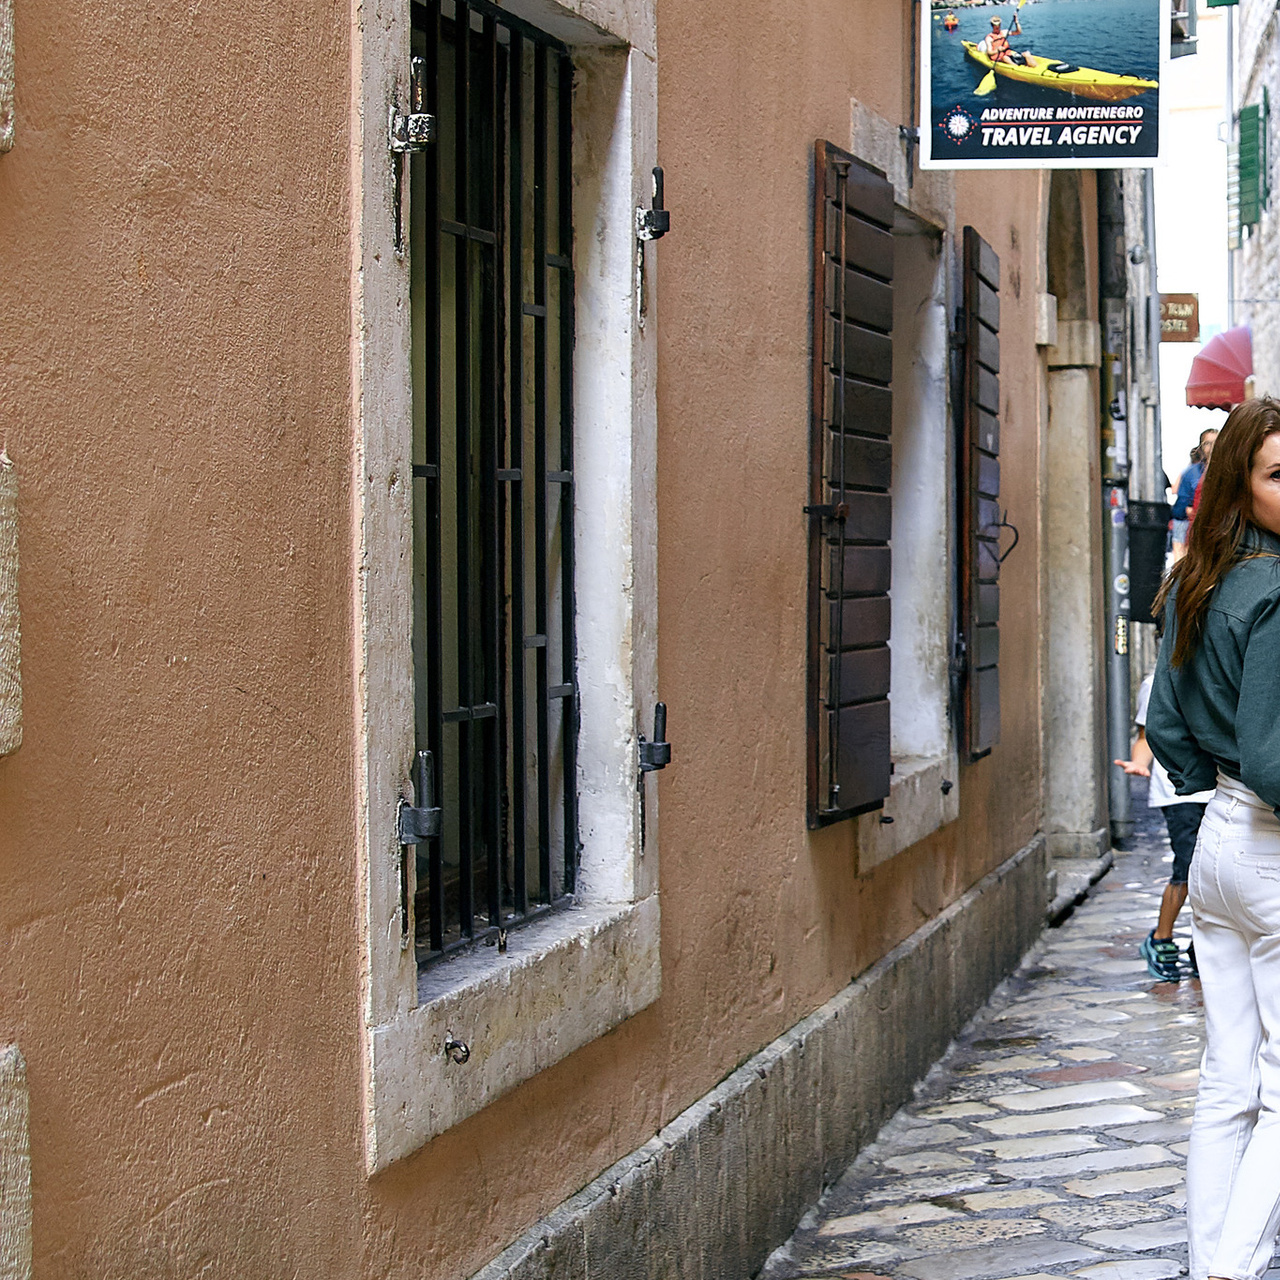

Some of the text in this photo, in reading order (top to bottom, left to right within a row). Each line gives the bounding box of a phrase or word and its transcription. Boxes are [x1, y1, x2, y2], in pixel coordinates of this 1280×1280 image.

[981, 106, 1143, 121] ADVENTURE MONTENEGRO
[981, 126, 1143, 146] TRAVEL AGENCY
